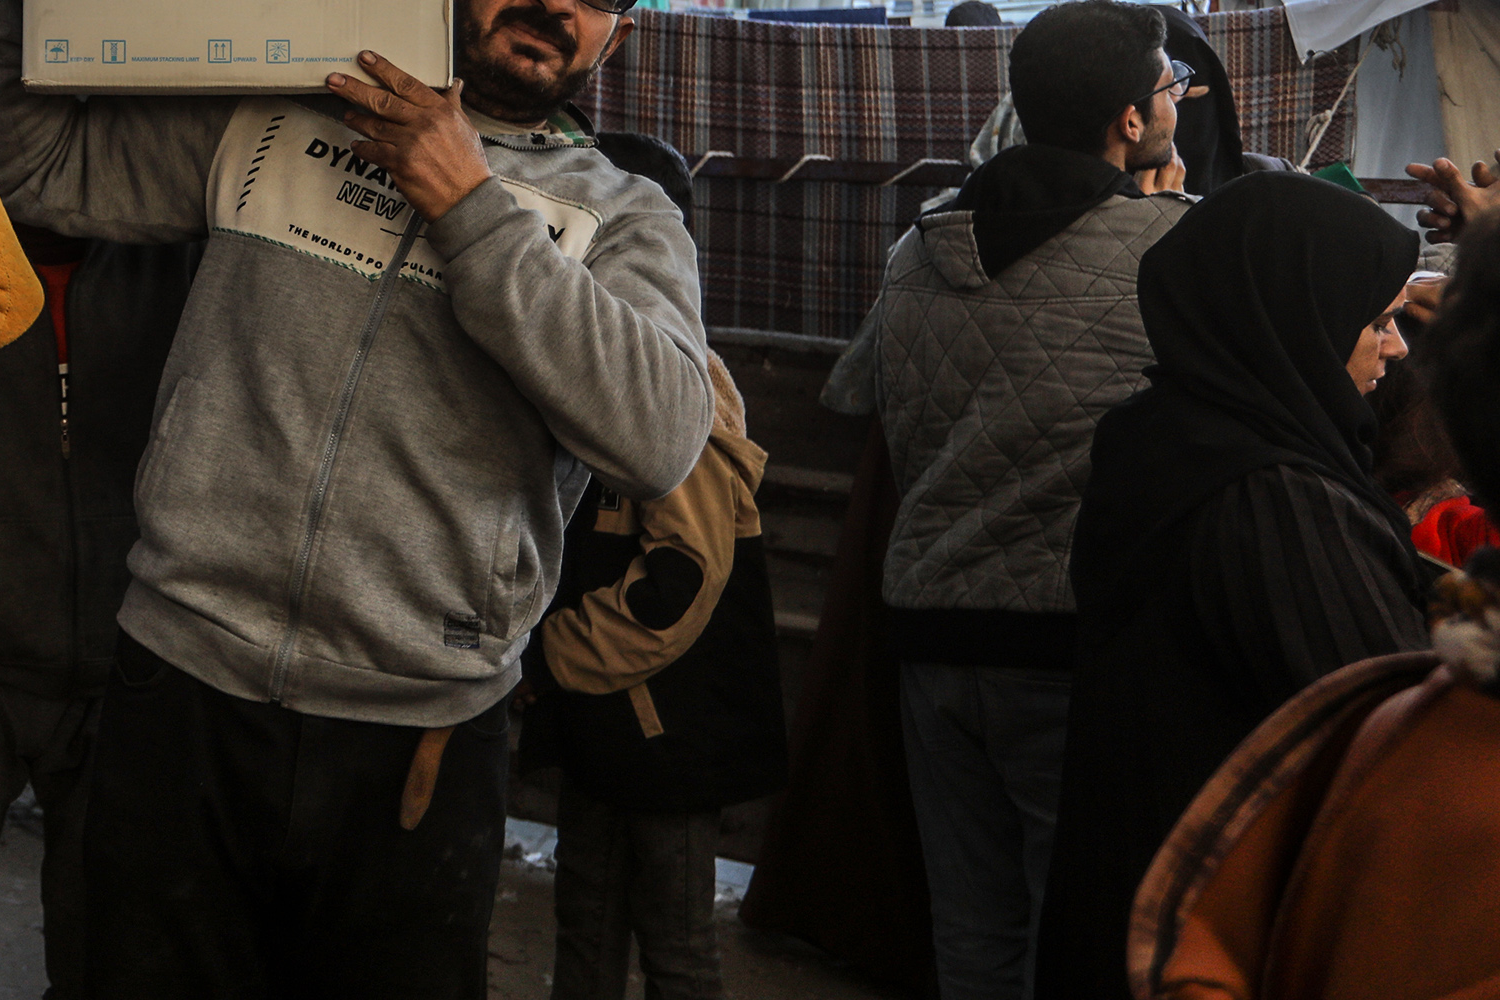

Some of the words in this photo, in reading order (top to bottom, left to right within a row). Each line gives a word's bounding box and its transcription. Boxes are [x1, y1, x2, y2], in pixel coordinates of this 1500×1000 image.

[336, 181, 406, 220] NEW
[288, 224, 310, 239] THE
[311, 234, 364, 261] WORLD'S
